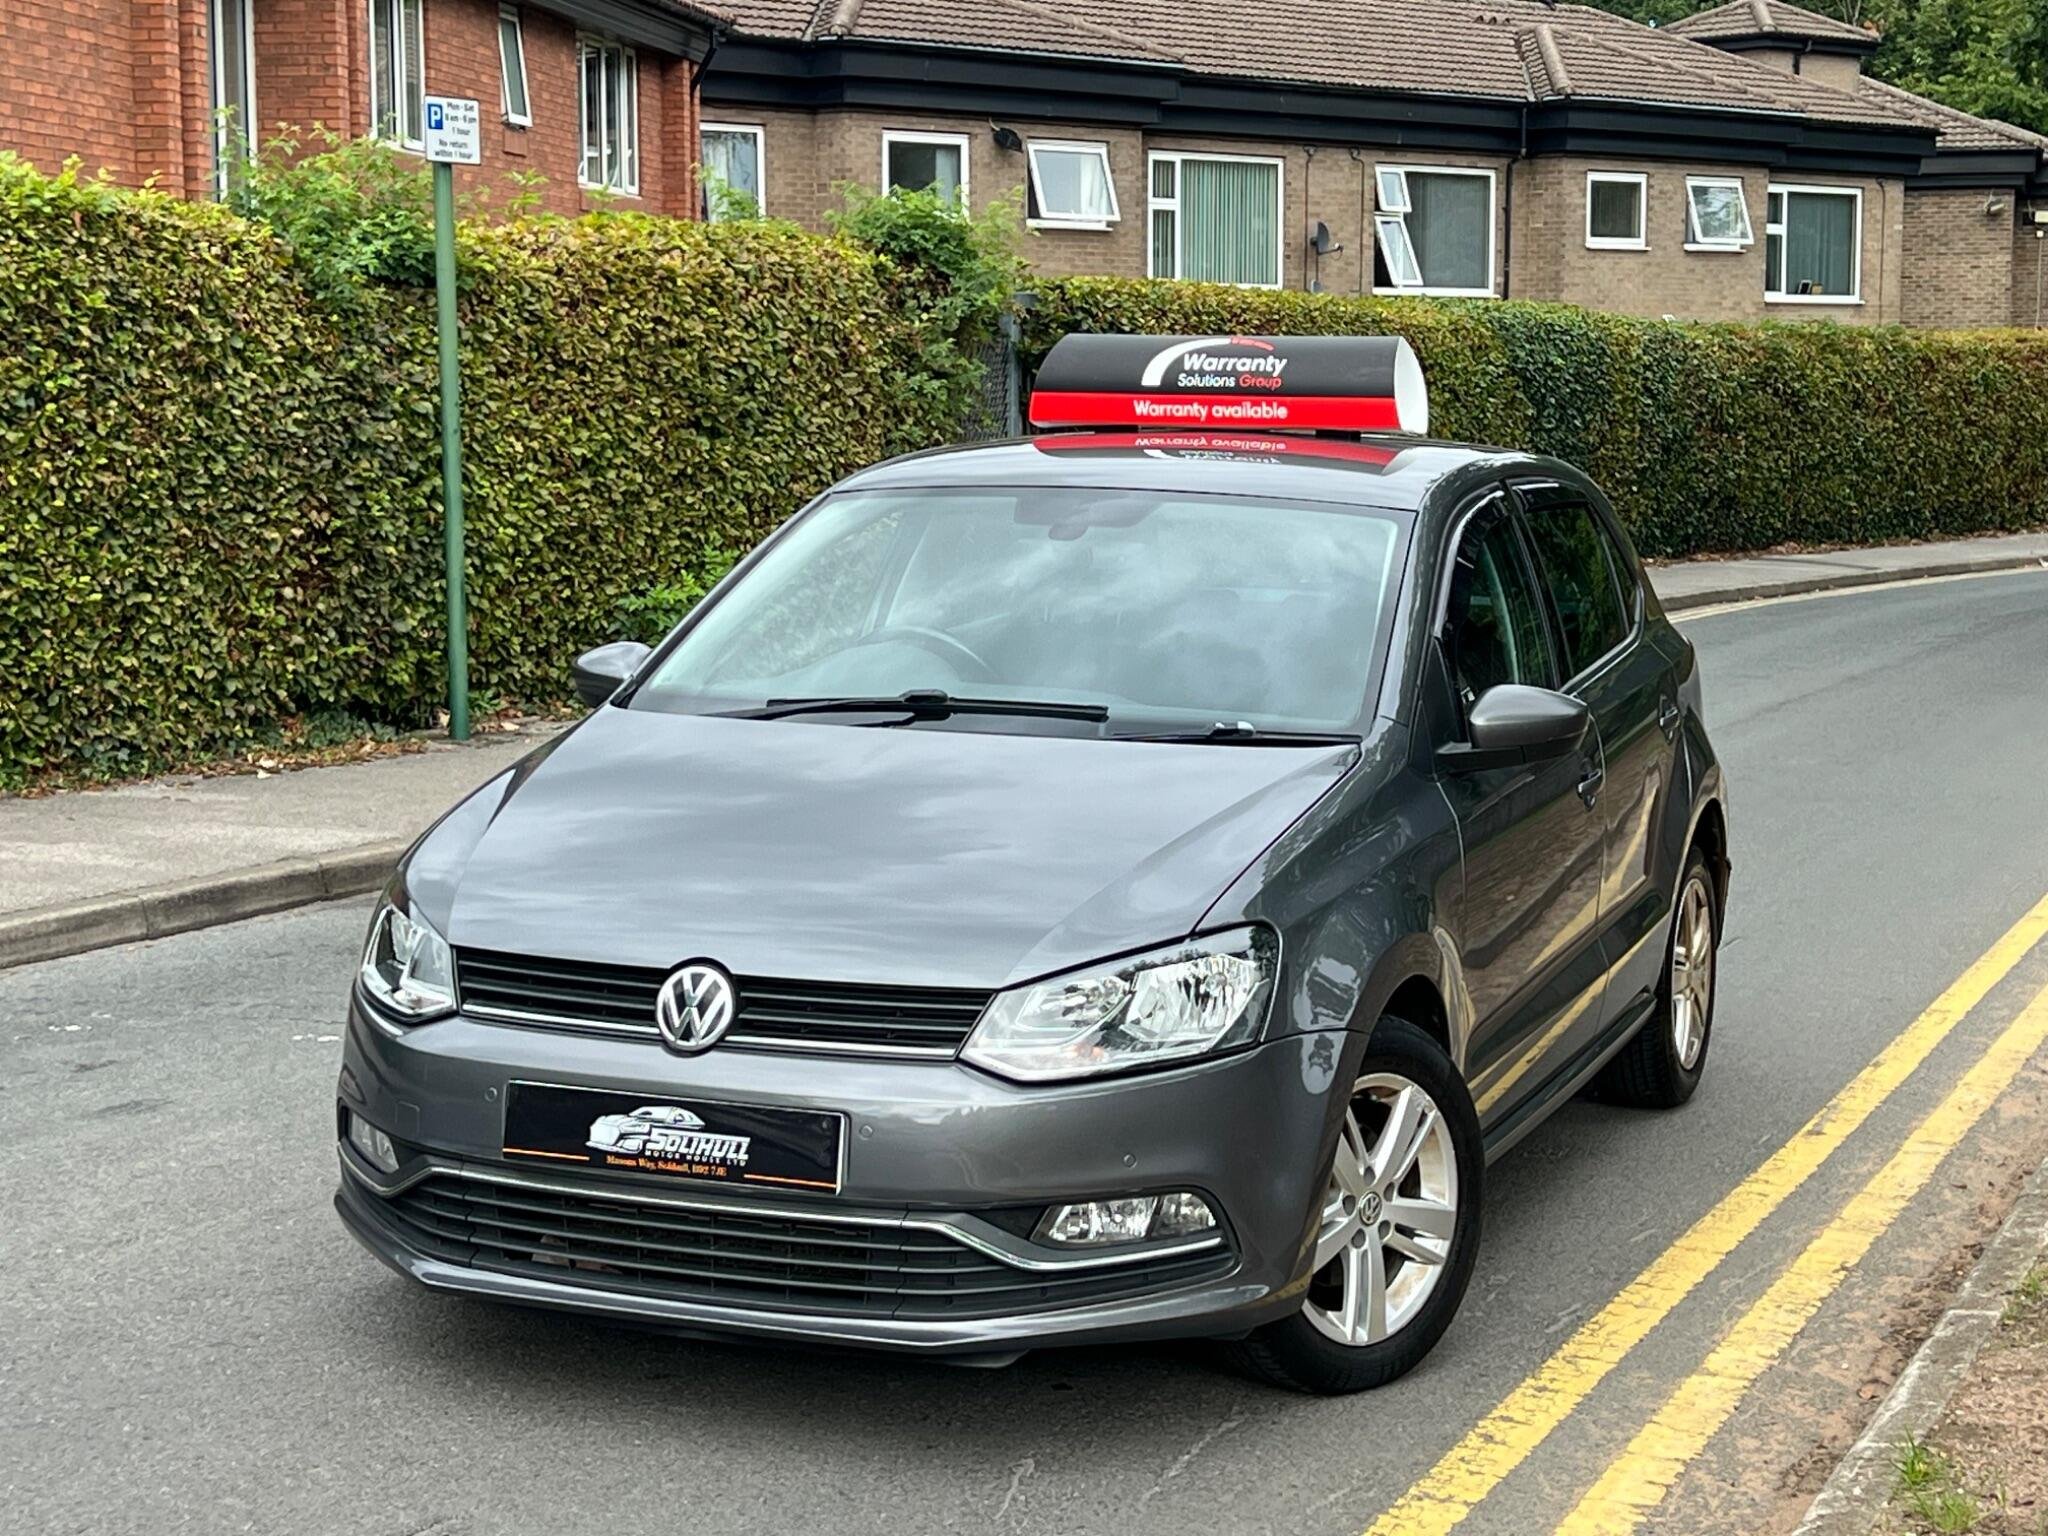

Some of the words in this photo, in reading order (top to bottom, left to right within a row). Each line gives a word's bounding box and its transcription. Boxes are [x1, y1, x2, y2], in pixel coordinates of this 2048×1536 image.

[430, 106, 442, 128] P
[457, 127, 471, 136] hour
[449, 141, 468, 149] return
[435, 149, 453, 158] within
[459, 151, 473, 160] hour
[1183, 353, 1288, 377] Warranty
[1177, 373, 1236, 387] Solutions
[1239, 374, 1282, 391] Group
[1133, 399, 1208, 421] Warranty
[1211, 401, 1288, 419] available
